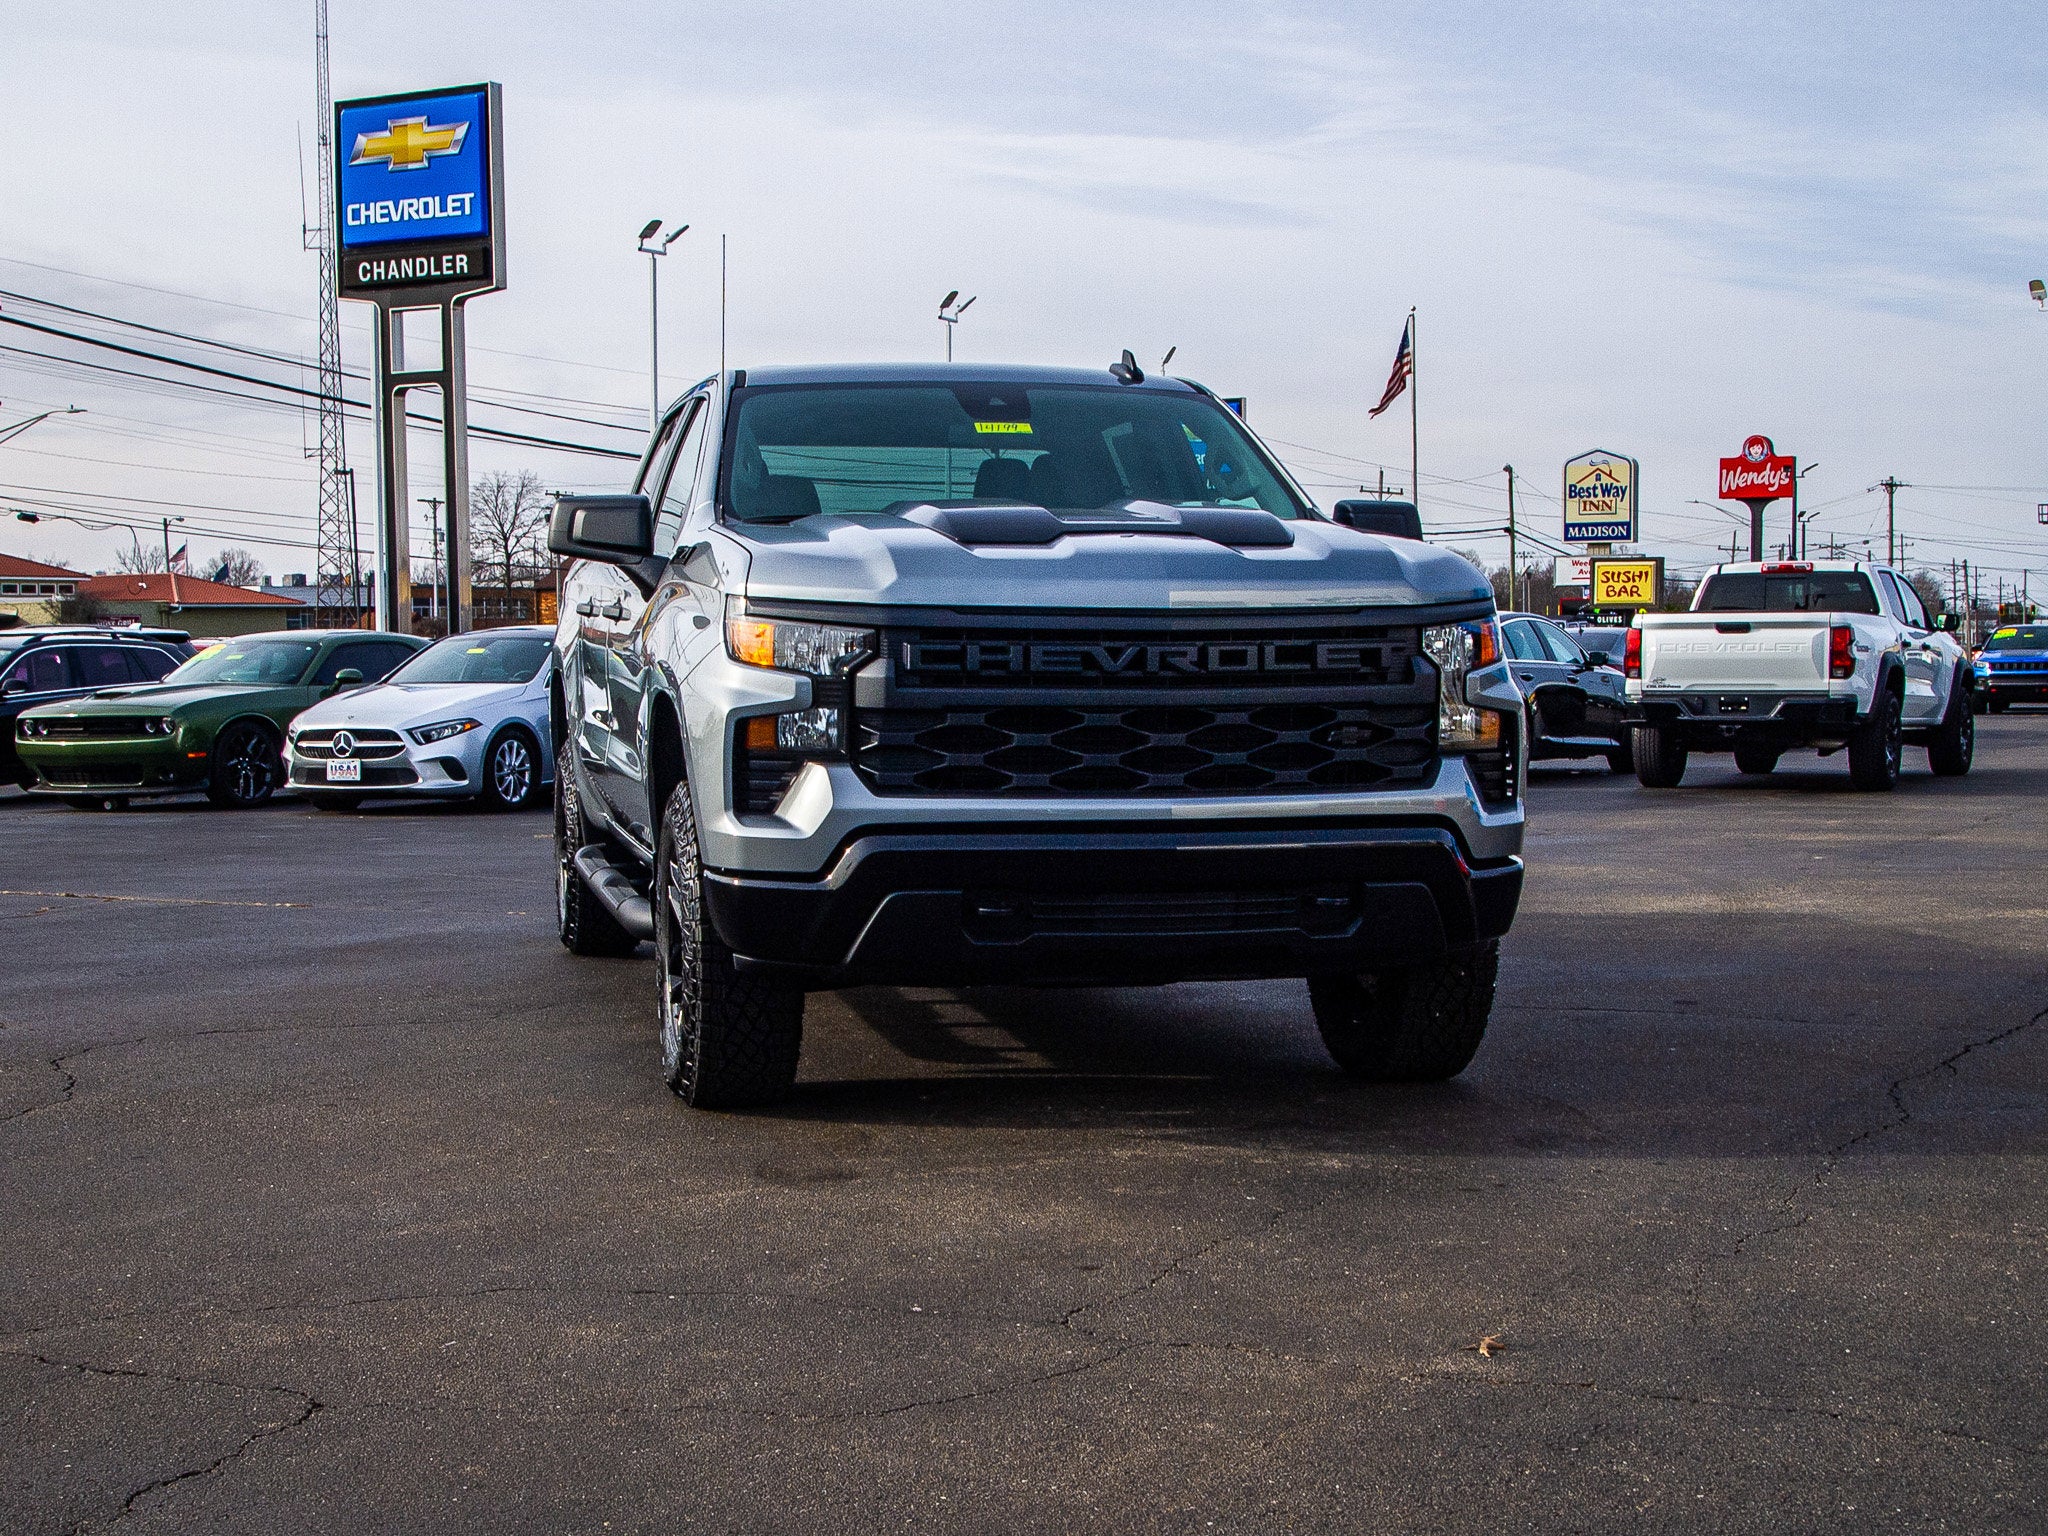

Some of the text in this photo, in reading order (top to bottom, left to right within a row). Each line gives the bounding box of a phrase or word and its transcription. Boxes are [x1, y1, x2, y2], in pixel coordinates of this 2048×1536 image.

[347, 192, 475, 226] CHEVROLET
[358, 254, 469, 282] CHANDLER
[1721, 462, 1791, 493] Wendy's
[1568, 483, 1628, 502] Best Way
[1582, 500, 1613, 512] INN
[1568, 525, 1628, 538] MADISON
[1600, 570, 1650, 584] SUSHI
[1606, 585, 1642, 598] BAR
[1659, 642, 1808, 654] CHEVROLET
[902, 640, 1407, 674] CHEVROLET
